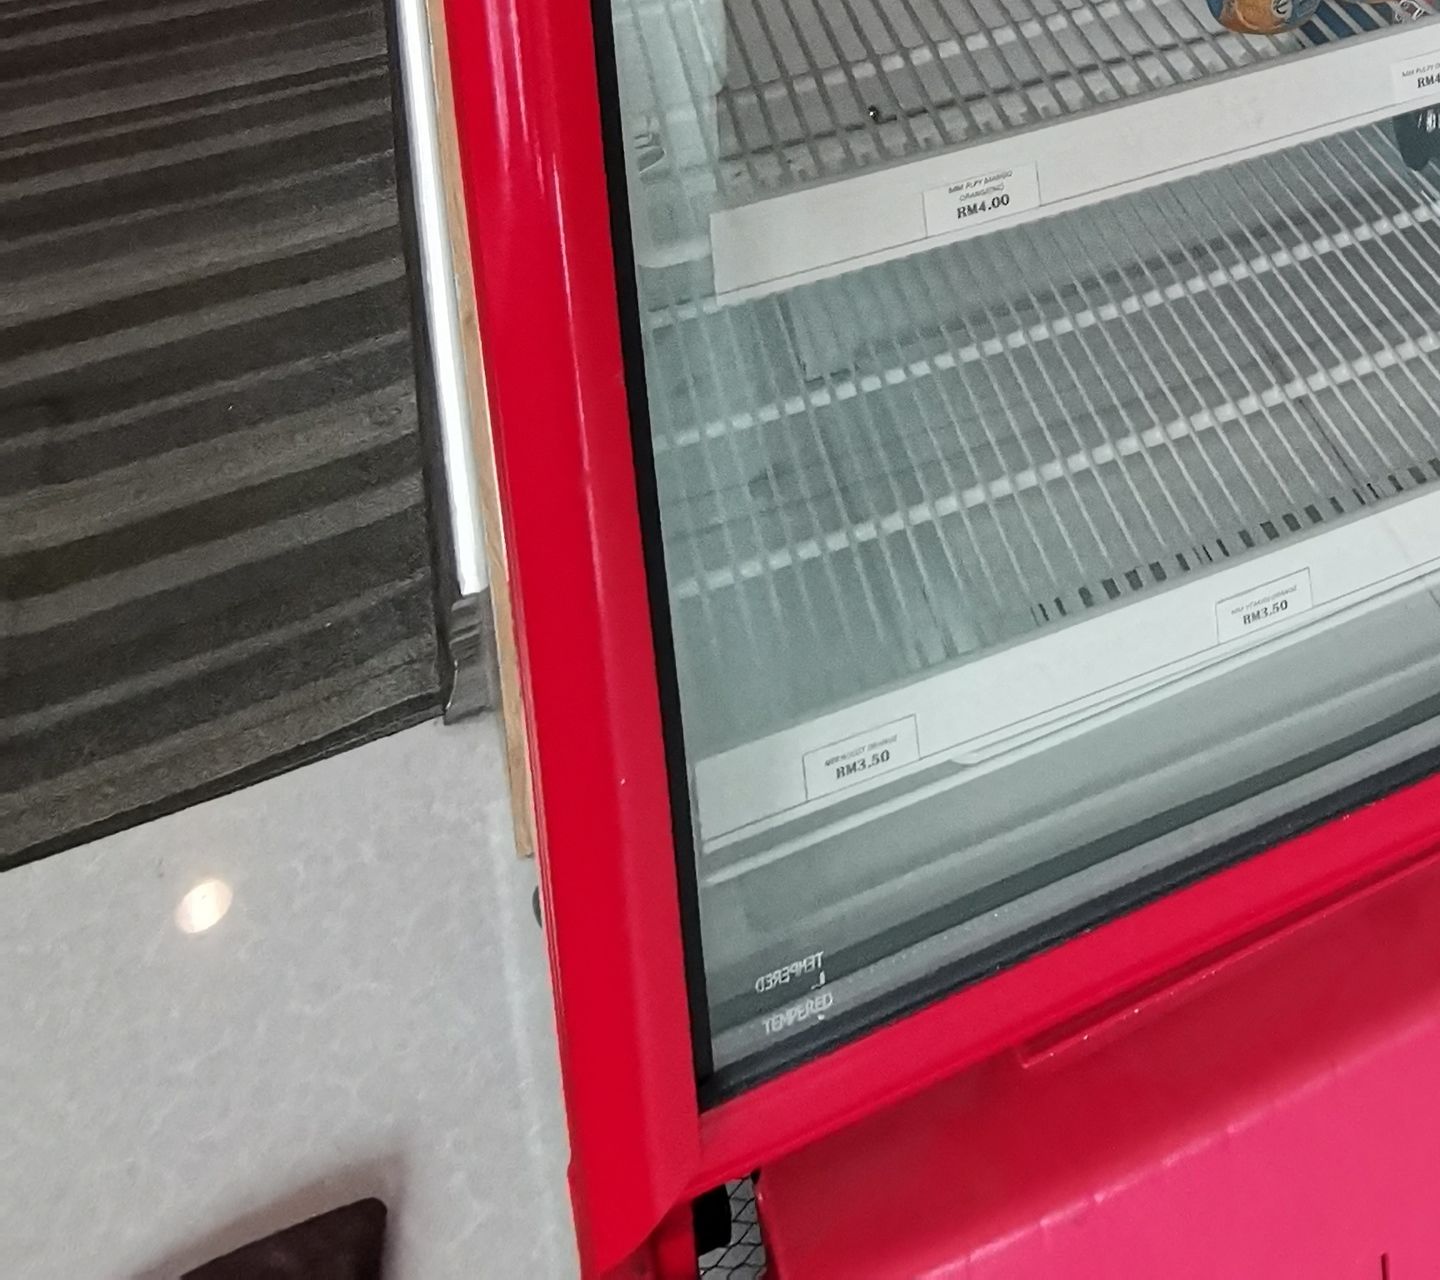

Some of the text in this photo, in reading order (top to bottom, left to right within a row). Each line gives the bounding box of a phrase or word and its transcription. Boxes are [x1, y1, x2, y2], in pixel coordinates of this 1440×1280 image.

[957, 193, 1010, 219] RM4.00
[1243, 599, 1288, 625] RM3.50
[836, 749, 890, 780] RM3.50
